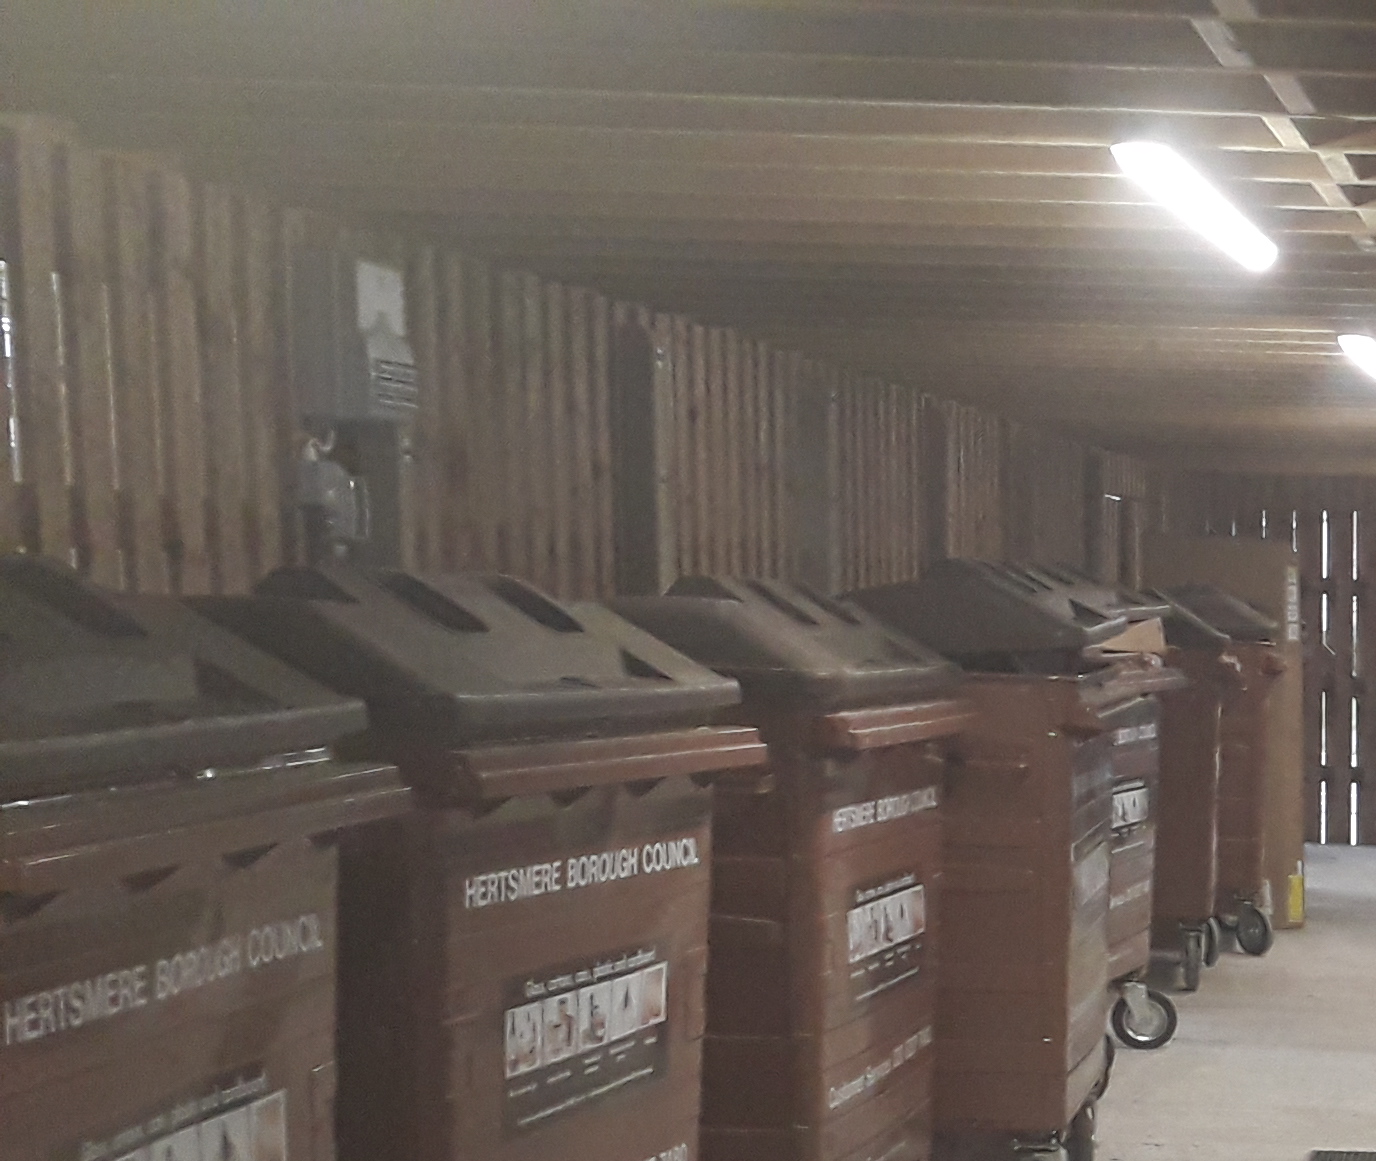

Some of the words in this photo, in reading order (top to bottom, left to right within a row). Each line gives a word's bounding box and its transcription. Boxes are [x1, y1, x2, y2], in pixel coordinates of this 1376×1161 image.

[465, 860, 562, 909] HERTSMERE
[567, 846, 638, 889] BOROUGH
[642, 837, 699, 875] COUNCIL
[6, 964, 148, 1045] HERTSMERE
[249, 913, 324, 967] COUNCIL
